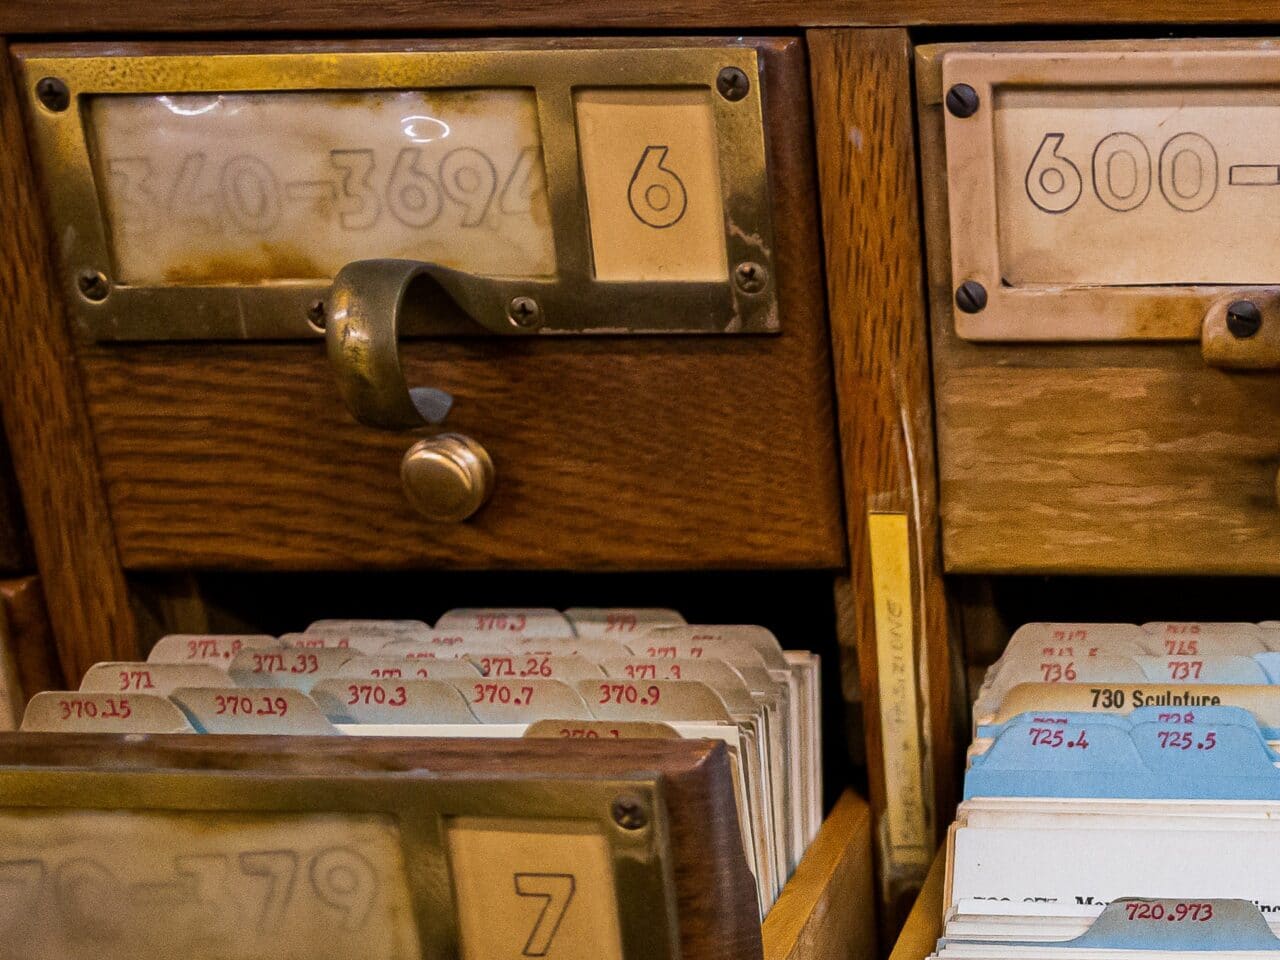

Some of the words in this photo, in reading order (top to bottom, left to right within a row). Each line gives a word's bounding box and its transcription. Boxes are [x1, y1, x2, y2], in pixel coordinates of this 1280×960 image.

[627, 145, 688, 229] 6
[252, 654, 320, 674] 371.33
[481, 658, 552, 678] 371.26
[1040, 662, 1077, 682] 736
[1167, 661, 1203, 682] 737
[119, 671, 155, 690] 371
[215, 695, 288, 716] 370.19
[348, 685, 407, 706] 370.3
[473, 684, 534, 706] 370.7
[598, 684, 660, 706] 370.9
[1090, 690, 1124, 708] 730
[1132, 690, 1221, 707] Sculpture
[59, 698, 132, 720] 370.15
[1029, 728, 1090, 749] 725.4
[1157, 731, 1217, 751] 725.5
[513, 872, 577, 957] 7
[1125, 902, 1213, 922] 720.973
